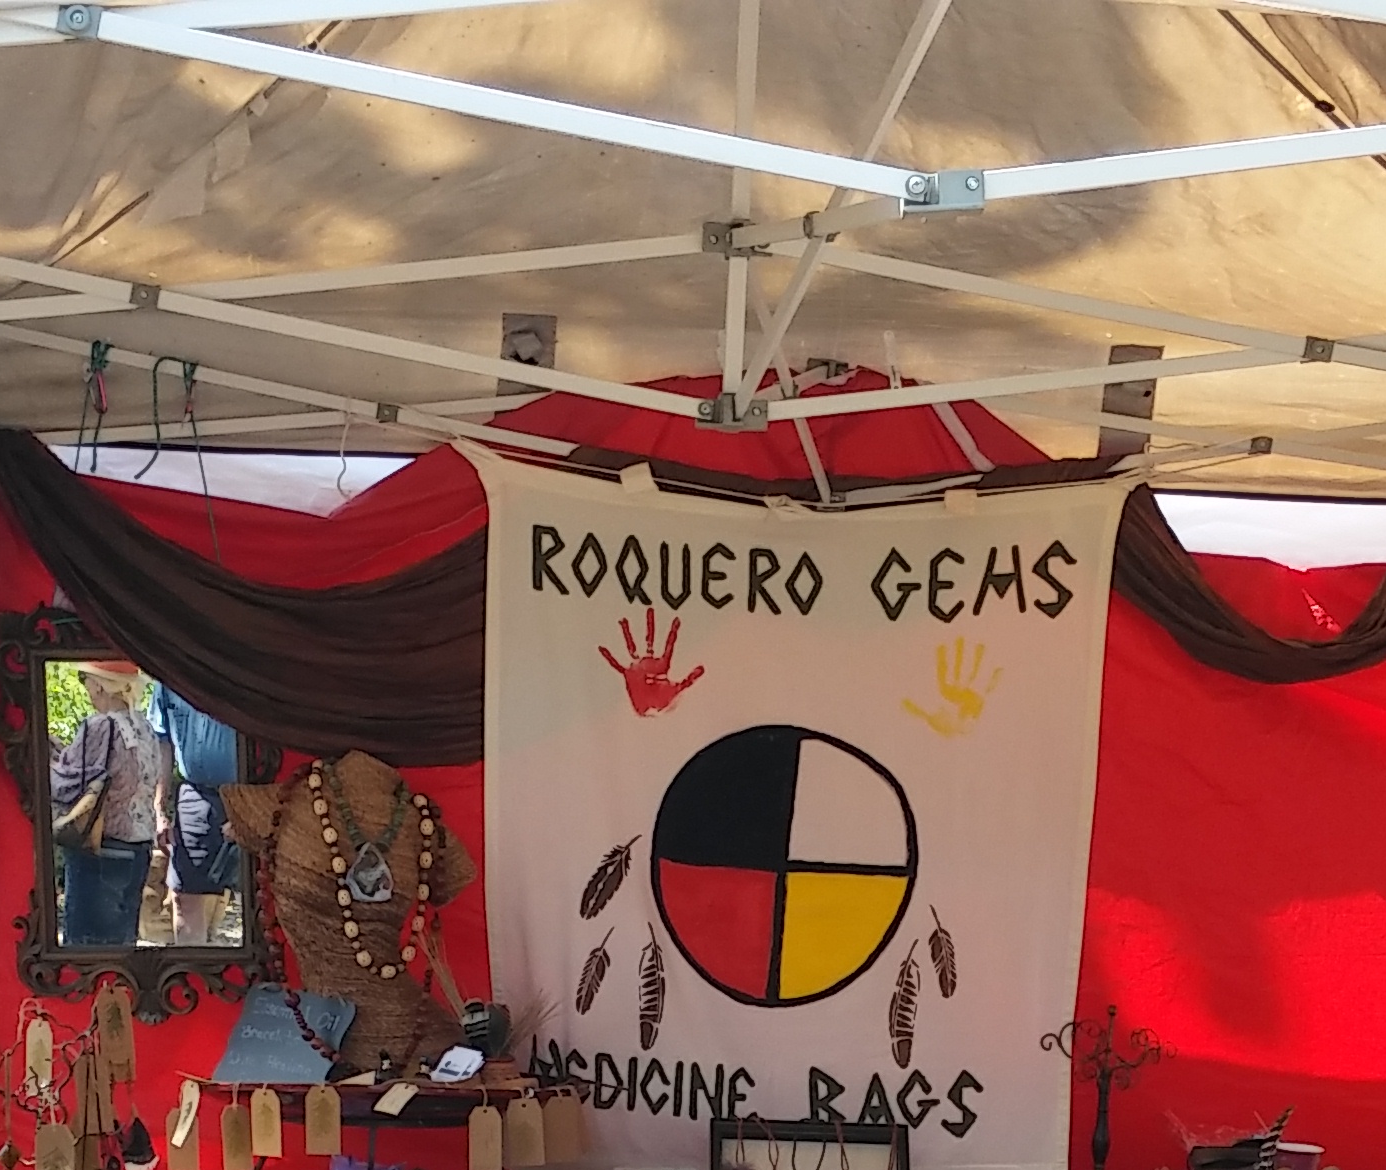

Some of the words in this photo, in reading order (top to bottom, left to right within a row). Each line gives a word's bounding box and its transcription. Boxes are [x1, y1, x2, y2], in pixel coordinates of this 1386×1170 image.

[531, 524, 824, 616] ROQUERO
[870, 539, 1078, 623] GEMS
[808, 1066, 984, 1139] BAGS
